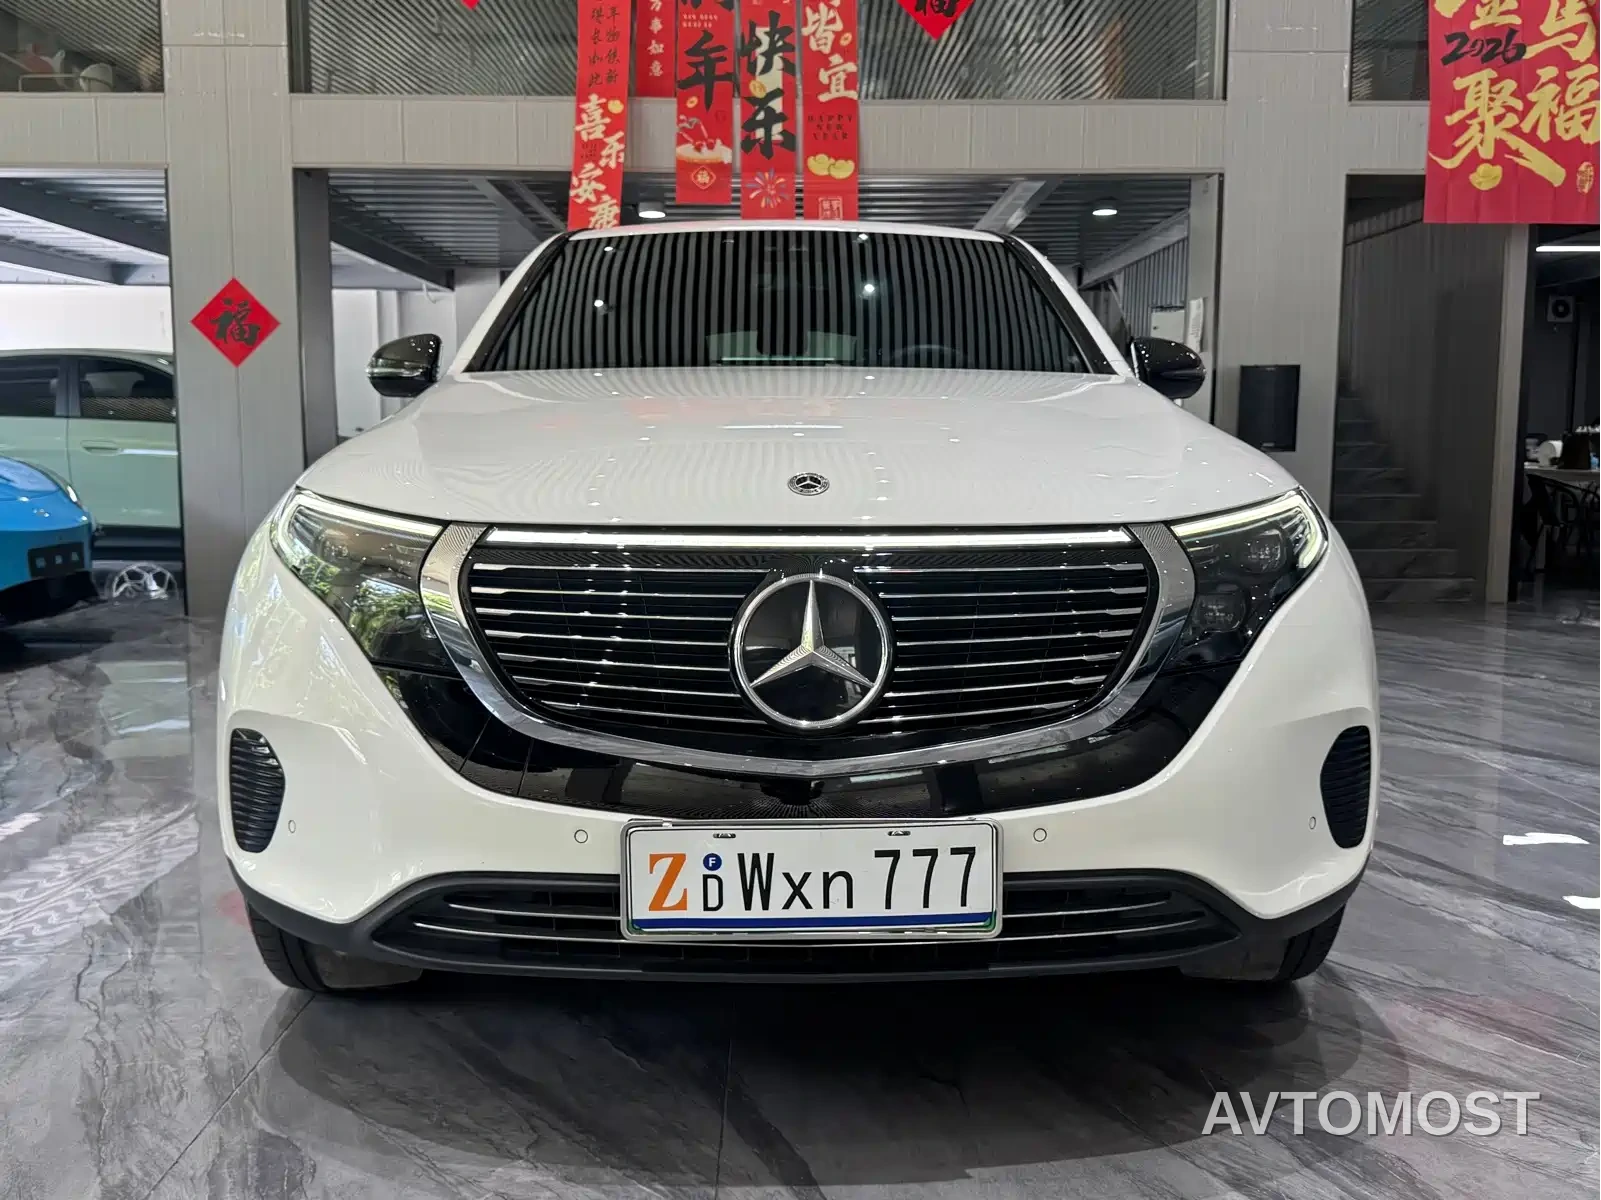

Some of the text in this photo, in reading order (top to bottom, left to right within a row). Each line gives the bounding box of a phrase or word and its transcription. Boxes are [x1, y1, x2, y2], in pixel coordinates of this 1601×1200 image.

[740, 10, 797, 160] 快乐
[801, 0, 859, 102] 皆宜
[1441, 28, 1527, 66] 2026
[569, 93, 625, 229] 喜乐安康
[1428, 64, 1601, 188] 聚福
[209, 297, 261, 347] 福
[648, 846, 977, 912] Z D Wxn 777
